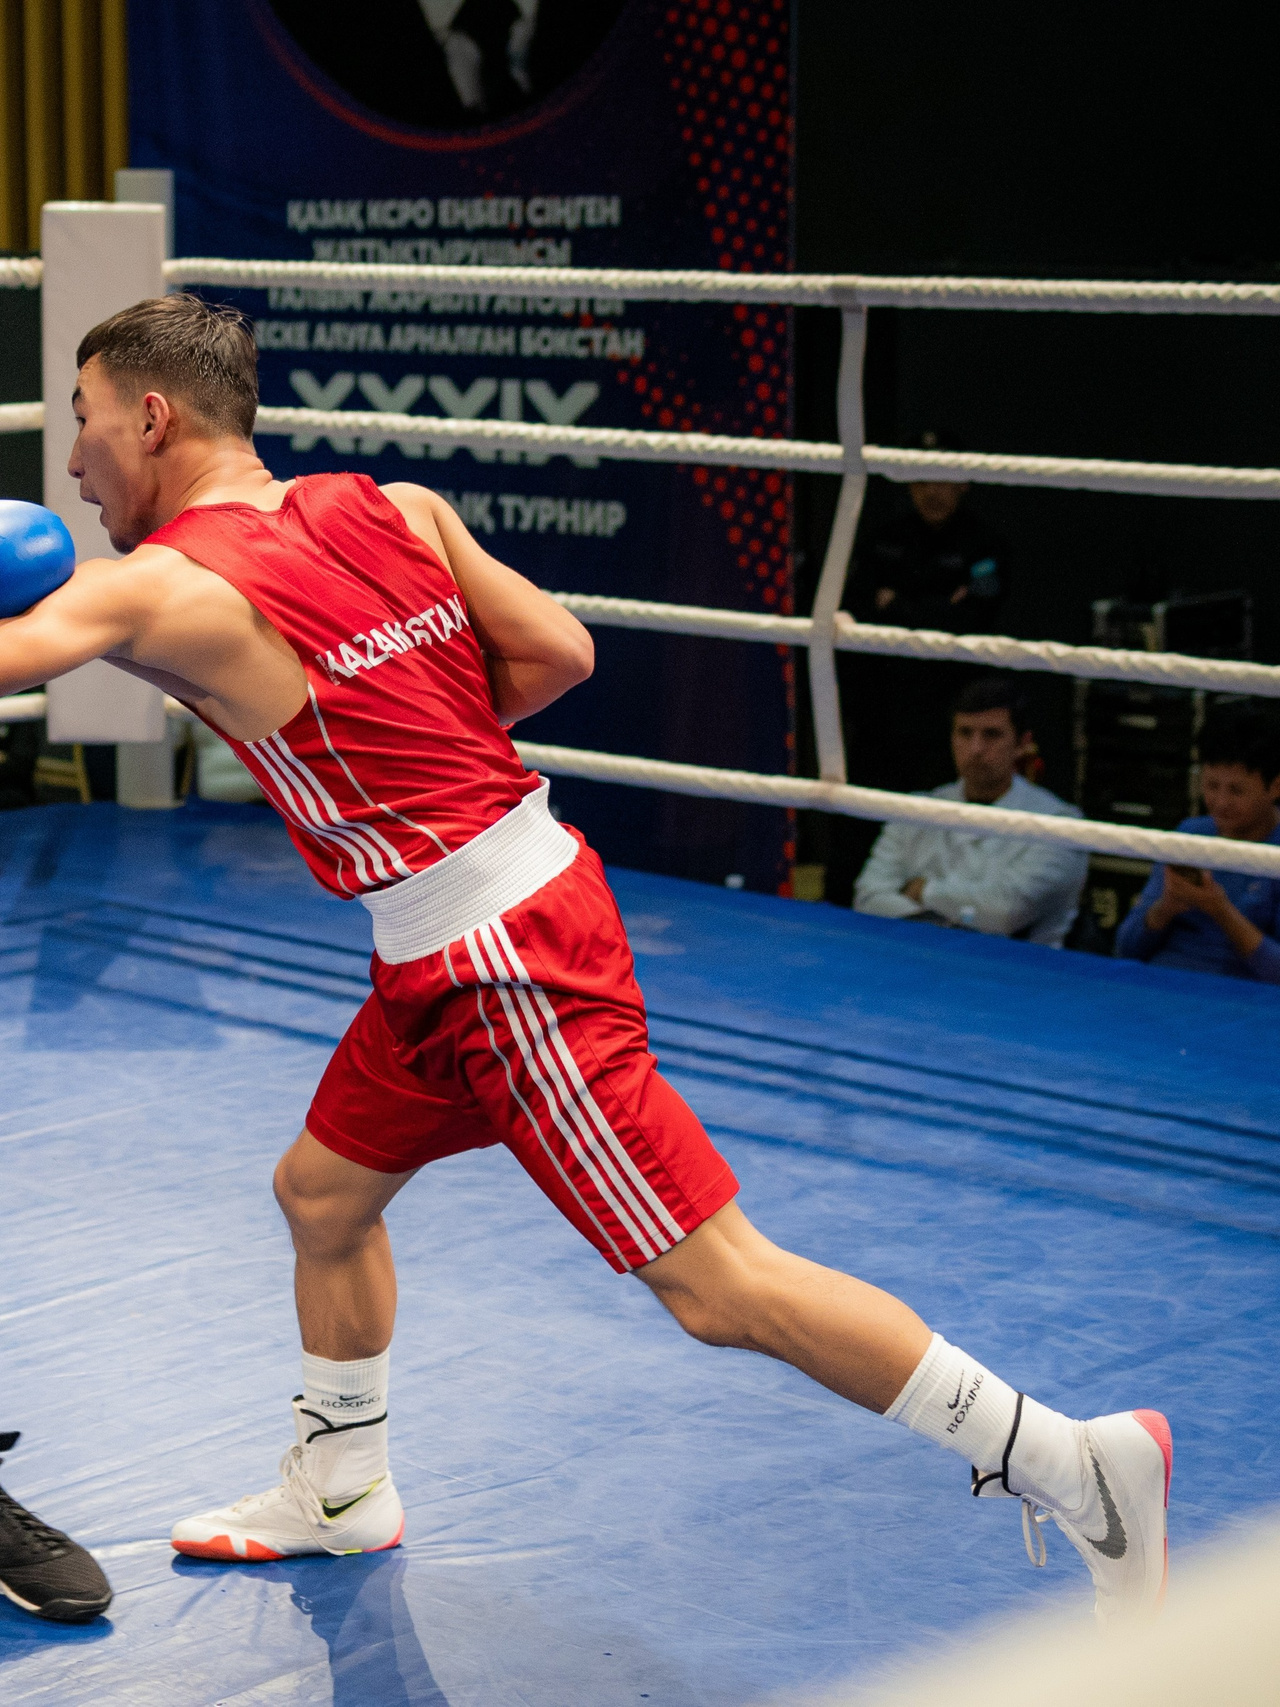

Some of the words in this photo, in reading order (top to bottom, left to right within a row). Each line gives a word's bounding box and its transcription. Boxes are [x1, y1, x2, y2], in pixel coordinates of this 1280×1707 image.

[367, 199, 434, 229] КСРО
[497, 493, 627, 538] ТУРНИР
[320, 1394, 382, 1409] BOXING
[945, 1372, 985, 1435] BOXING
